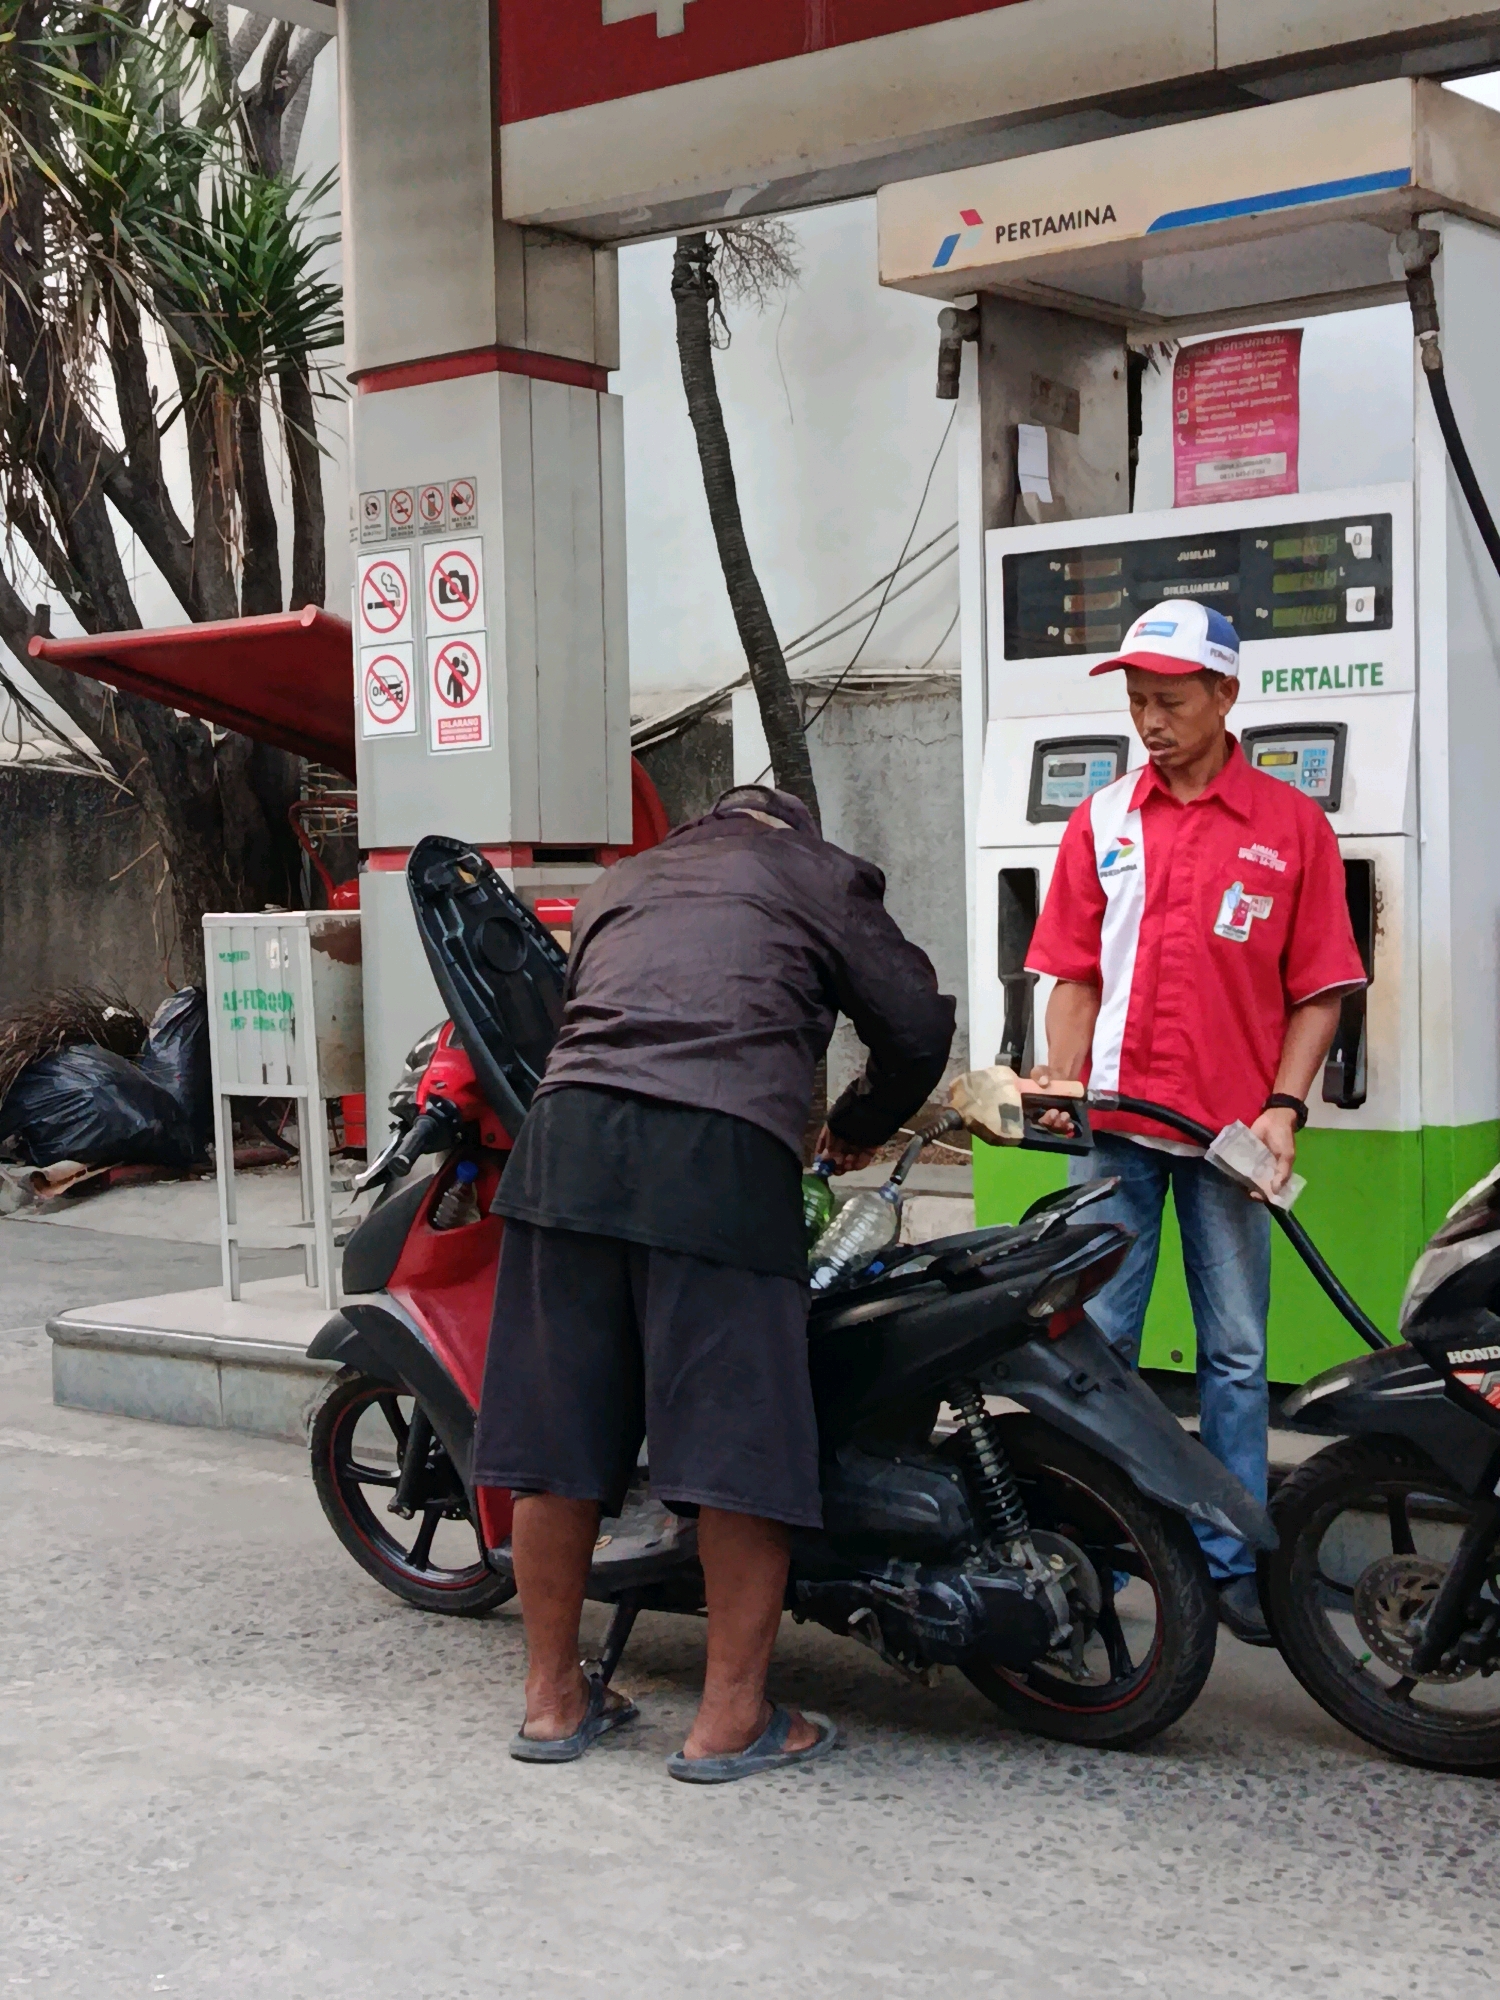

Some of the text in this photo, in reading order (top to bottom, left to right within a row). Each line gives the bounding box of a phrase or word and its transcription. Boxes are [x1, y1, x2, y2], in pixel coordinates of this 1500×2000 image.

[995, 204, 1117, 244] PERTAMINA
[1177, 548, 1217, 562] JUMLAH
[1163, 580, 1230, 596] DIKELUARKAN
[1262, 662, 1384, 694] PERTALITE
